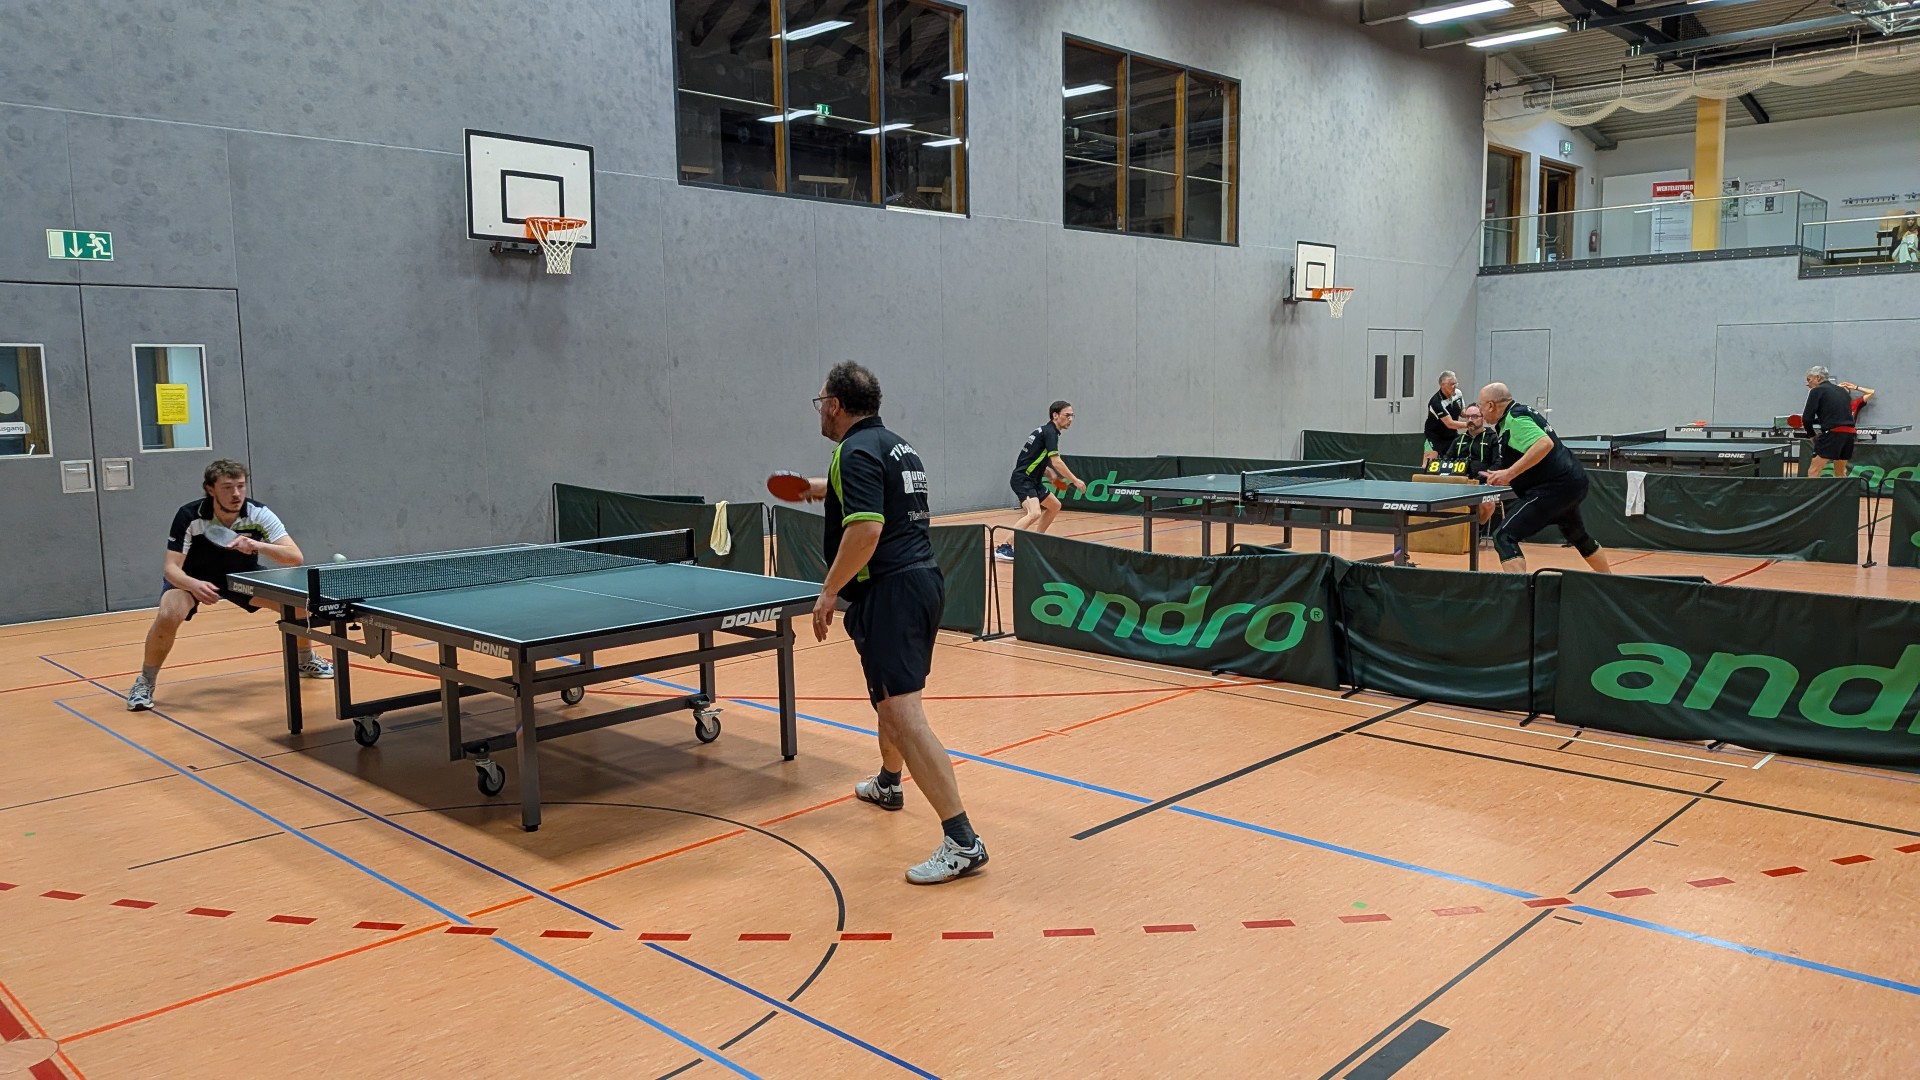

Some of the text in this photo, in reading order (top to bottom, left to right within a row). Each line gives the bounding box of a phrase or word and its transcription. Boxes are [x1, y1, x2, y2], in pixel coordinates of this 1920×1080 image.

[1429, 461, 1440, 472] 8
[1453, 461, 1466, 473] 10
[1114, 488, 1141, 496] DONIC
[1382, 502, 1419, 511] DONIC
[232, 581, 254, 596] DONIC
[318, 603, 340, 612] GEWO
[720, 606, 783, 630] DONIC
[472, 639, 510, 659] DONIC
[1590, 642, 1920, 735] and
